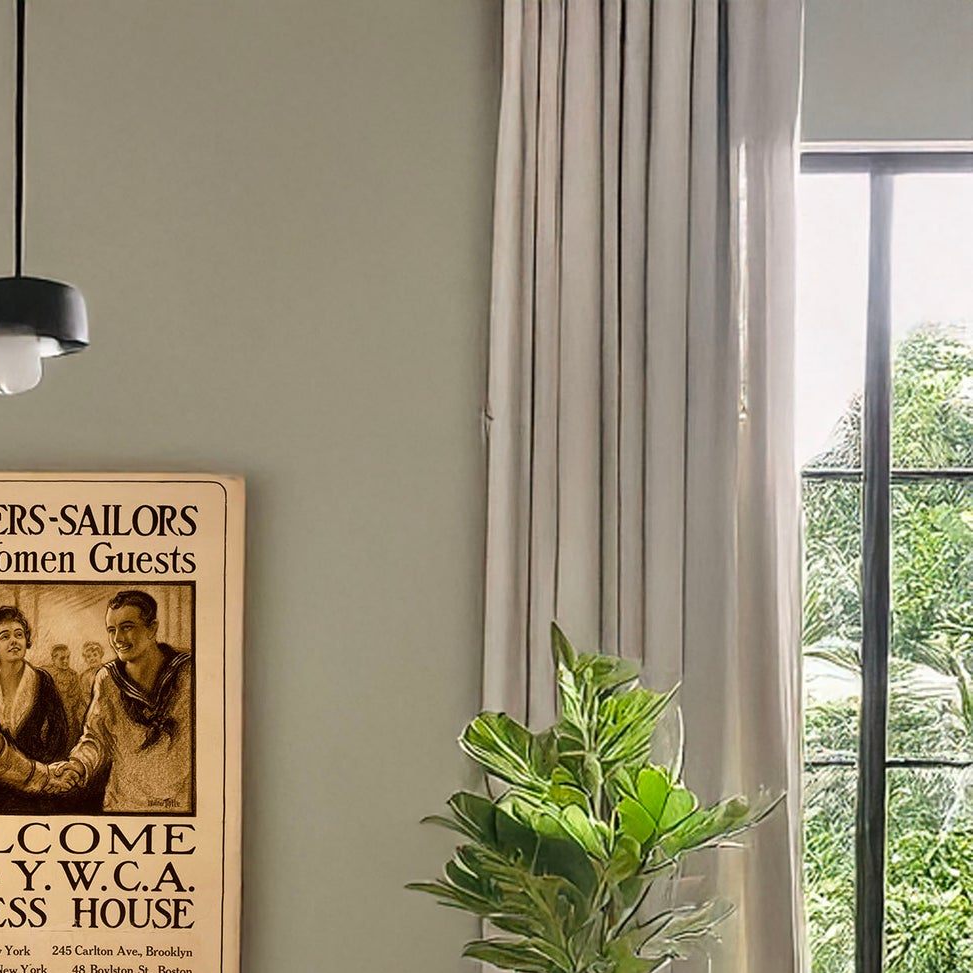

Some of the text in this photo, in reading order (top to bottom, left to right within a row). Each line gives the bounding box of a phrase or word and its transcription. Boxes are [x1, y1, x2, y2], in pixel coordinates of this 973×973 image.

[89, 542, 197, 574] Guests
[72, 898, 195, 929] HOUSE
[4, 945, 31, 956] York
[52, 945, 193, 959] 245 Carlton Ave., Brooklyn
